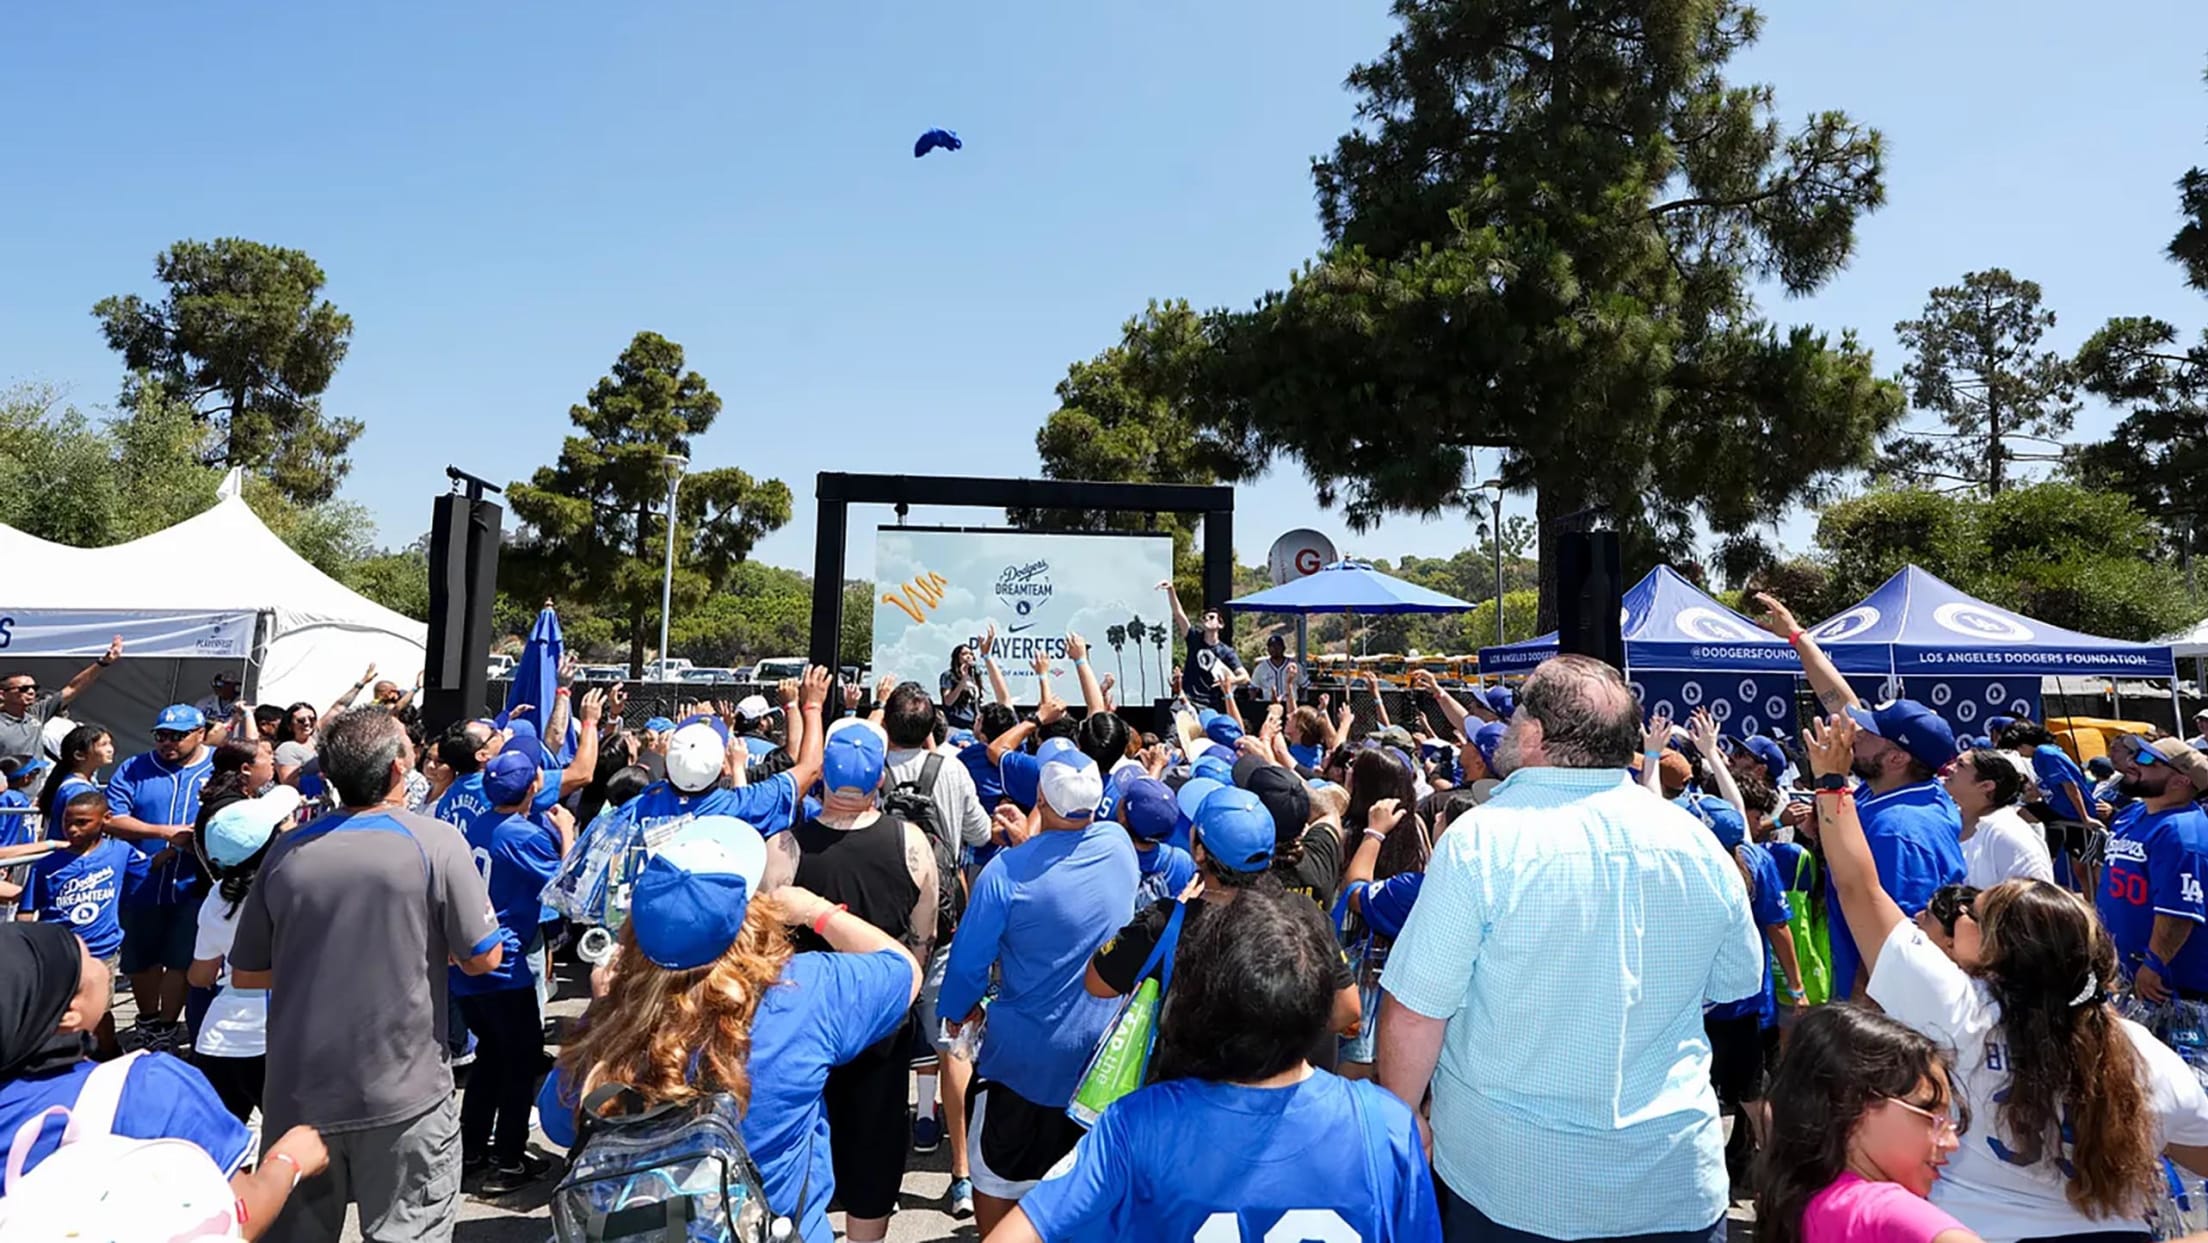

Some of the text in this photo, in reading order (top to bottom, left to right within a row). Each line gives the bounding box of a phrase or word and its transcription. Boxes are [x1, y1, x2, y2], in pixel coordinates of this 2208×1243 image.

[1295, 548, 1321, 575] G
[995, 583, 1052, 596] DREAMTEAM
[969, 637, 1077, 660] PAYERFES
[1919, 652, 2148, 666] LOS ANGELES DODGERS FOUNDATION
[2108, 866, 2148, 907] 50
[2180, 872, 2204, 904] LA
